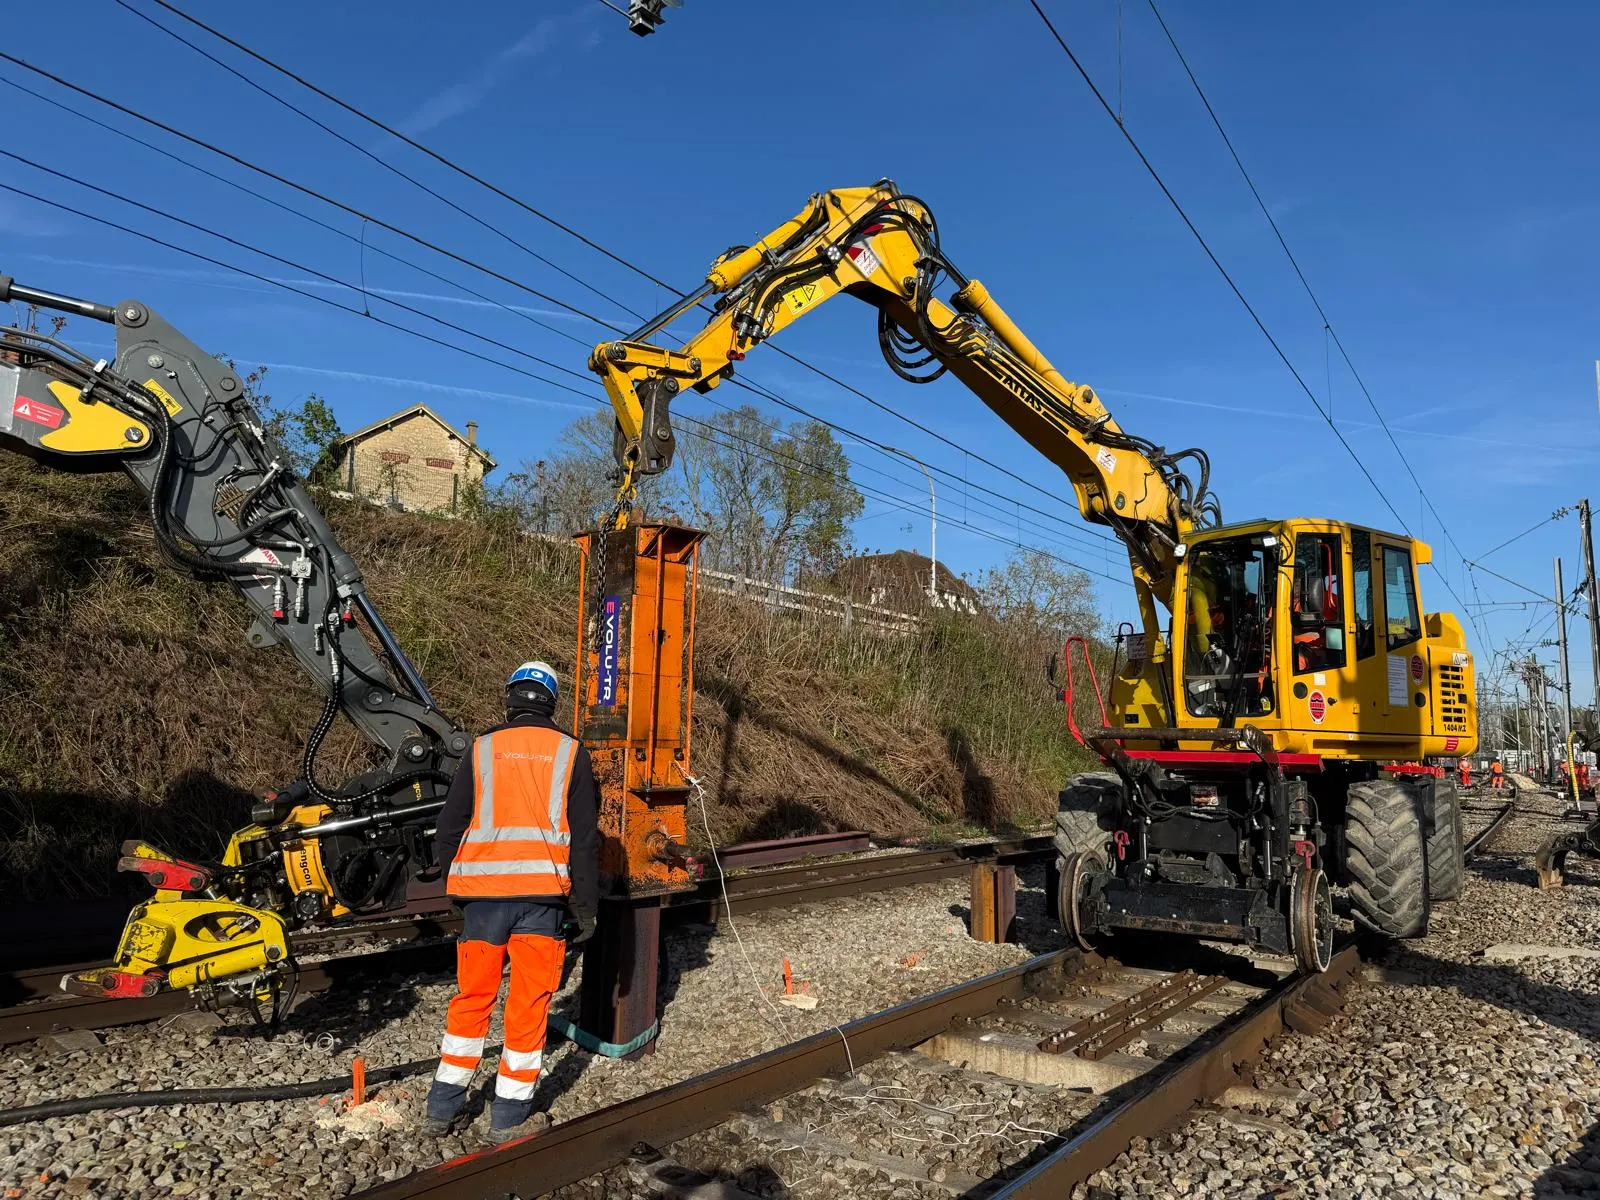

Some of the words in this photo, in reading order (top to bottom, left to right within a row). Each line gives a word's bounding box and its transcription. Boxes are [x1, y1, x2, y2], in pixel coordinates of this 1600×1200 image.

[1002, 374, 1043, 413] ATLAS
[603, 601, 615, 700] EVOLU-TR
[299, 848, 313, 886] engcon
